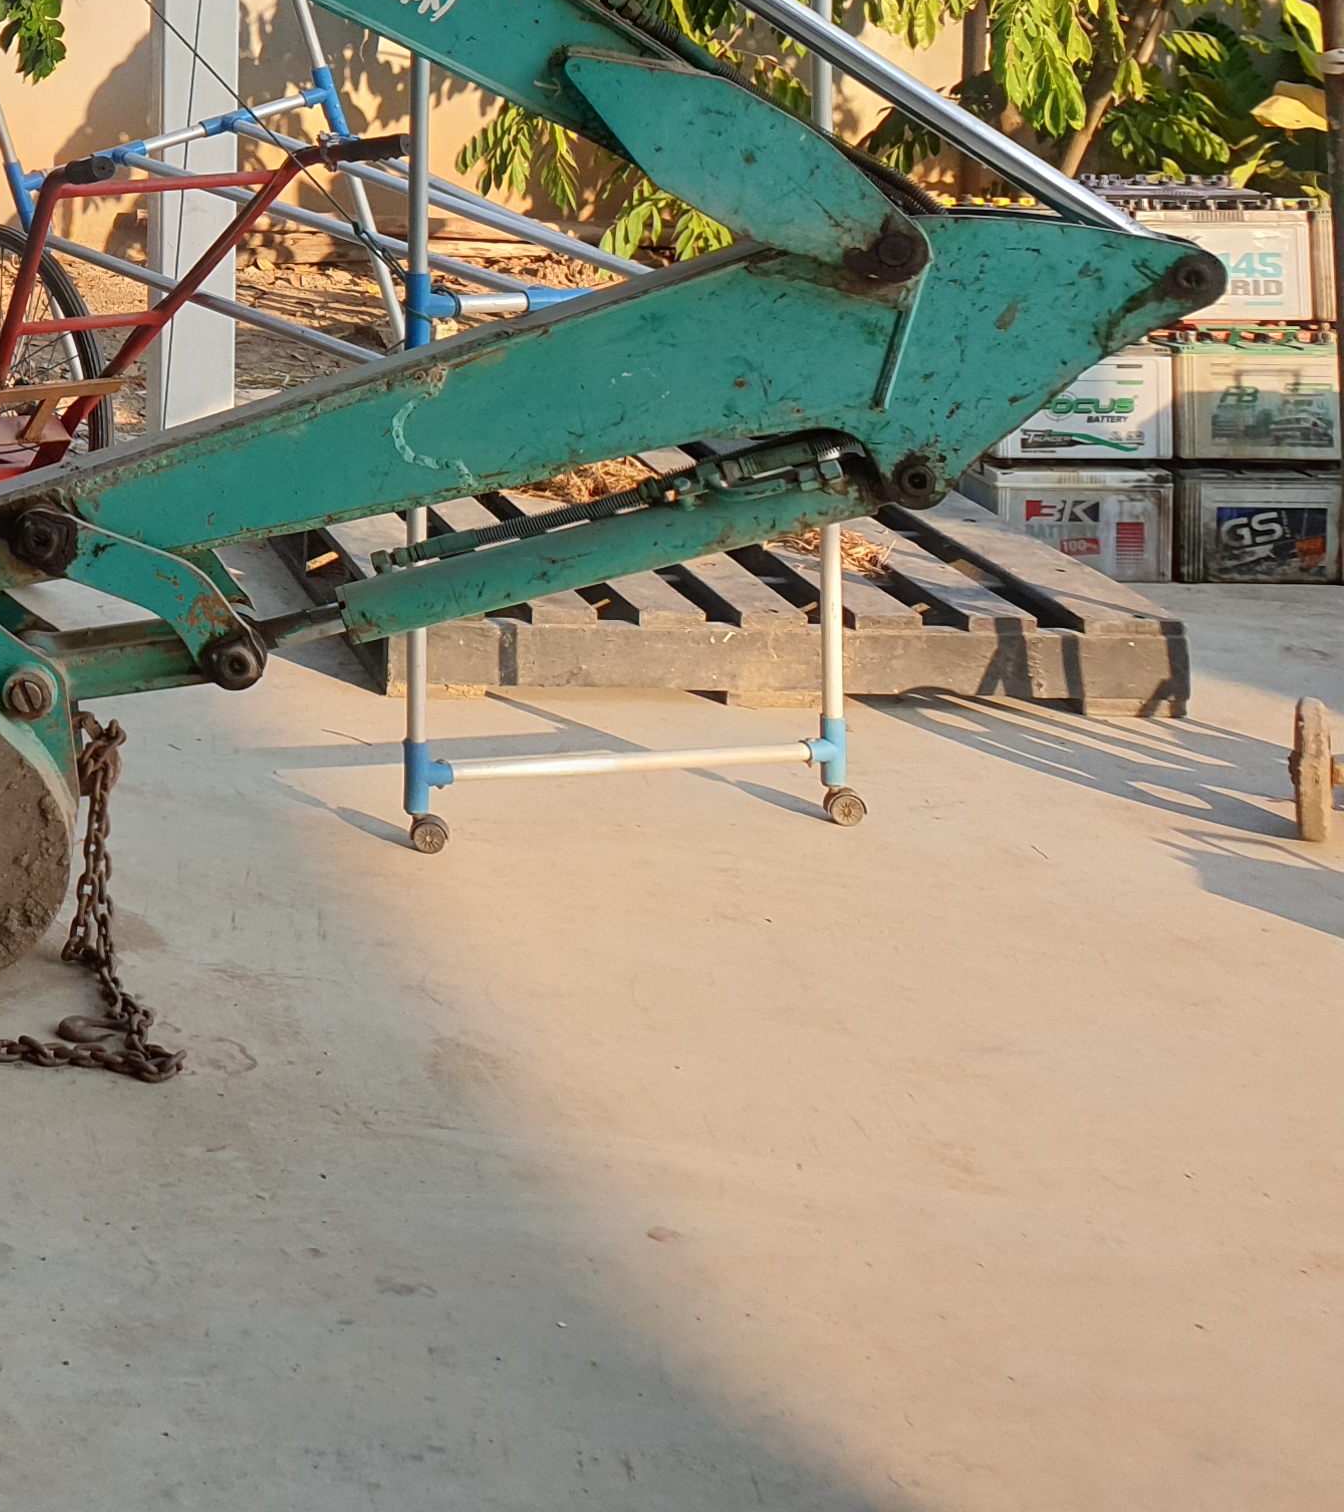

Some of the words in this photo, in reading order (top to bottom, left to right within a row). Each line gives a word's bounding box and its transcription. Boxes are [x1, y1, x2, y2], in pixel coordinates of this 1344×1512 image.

[1048, 397, 1135, 414] OCUS
[1086, 415, 1129, 424] BATTERY
[1220, 511, 1284, 548] GS
